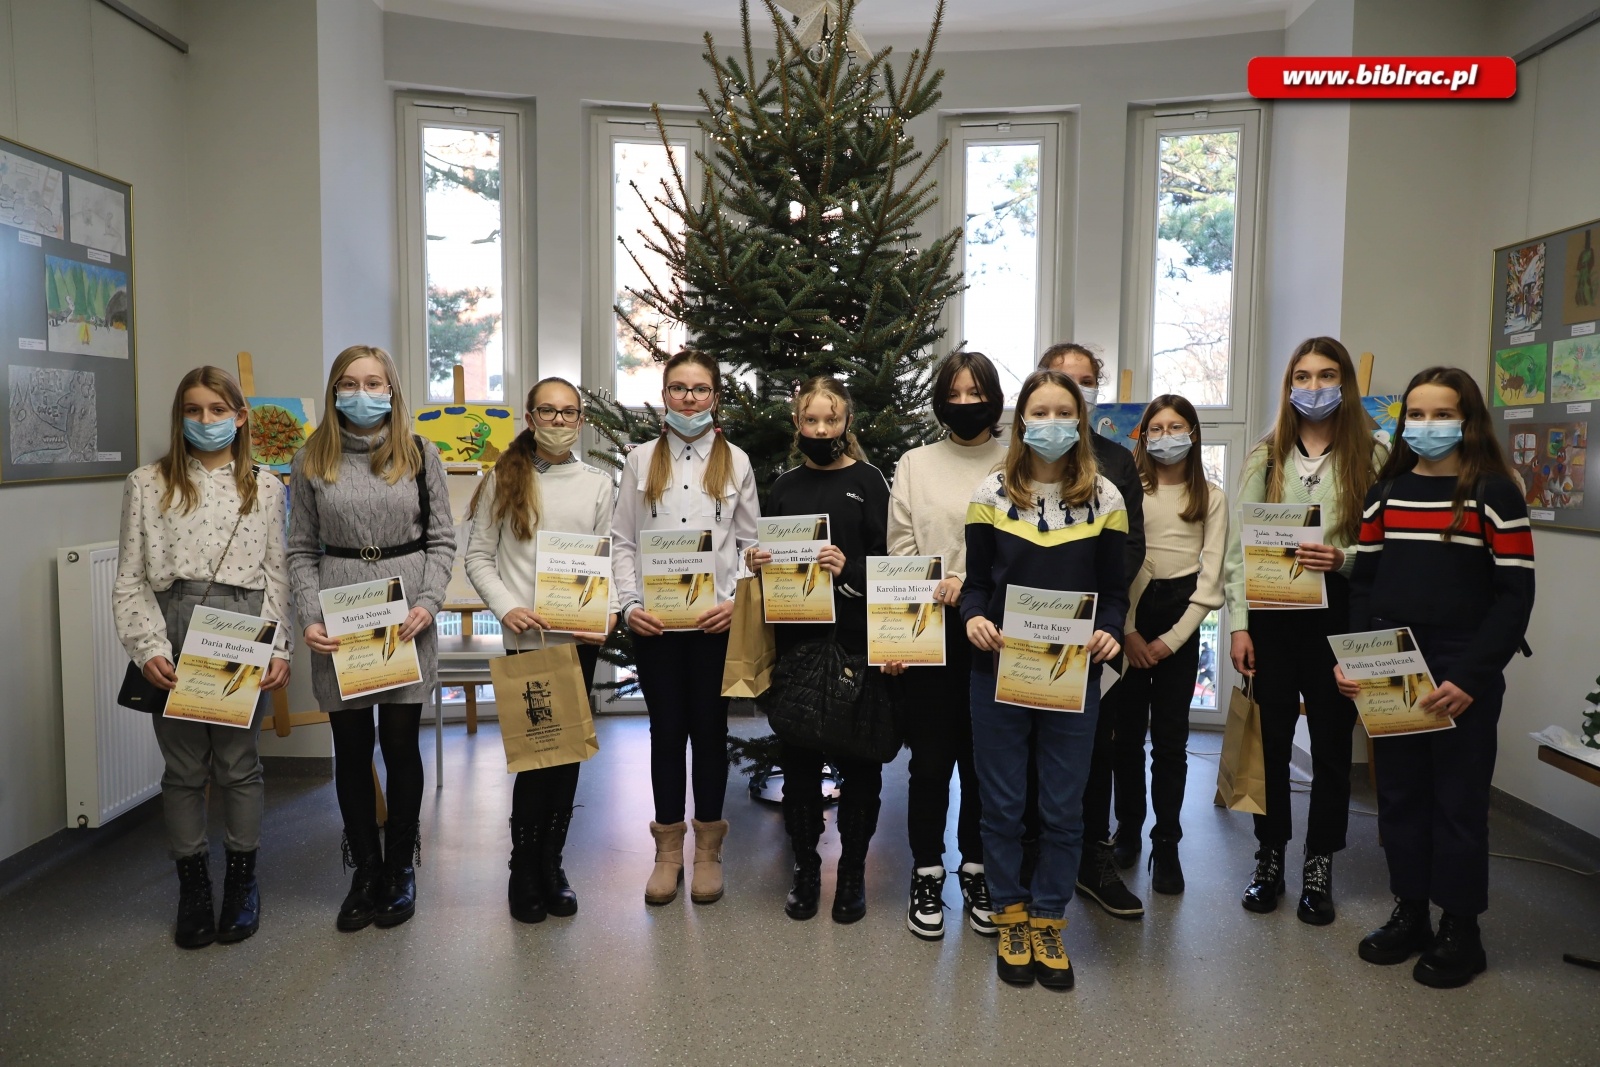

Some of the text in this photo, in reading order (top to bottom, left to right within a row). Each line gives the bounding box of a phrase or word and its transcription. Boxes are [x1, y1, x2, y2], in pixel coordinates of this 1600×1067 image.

[1252, 508, 1302, 522] Dyplom
[767, 523, 812, 538] Dyplom
[548, 536, 594, 550] Dyplom
[650, 535, 696, 549] Dyplom
[877, 562, 925, 576] Dyplom
[334, 587, 384, 606] Dyplom
[1017, 593, 1074, 610] Dyplom
[202, 614, 257, 633] Dyplom
[342, 608, 392, 624] Maria Nowak
[1024, 620, 1071, 634] Marta Kusy
[201, 638, 254, 654] Daria Rudzok
[1342, 637, 1394, 653] Dyplom
[1346, 656, 1415, 670] Paulina Gawliczek
